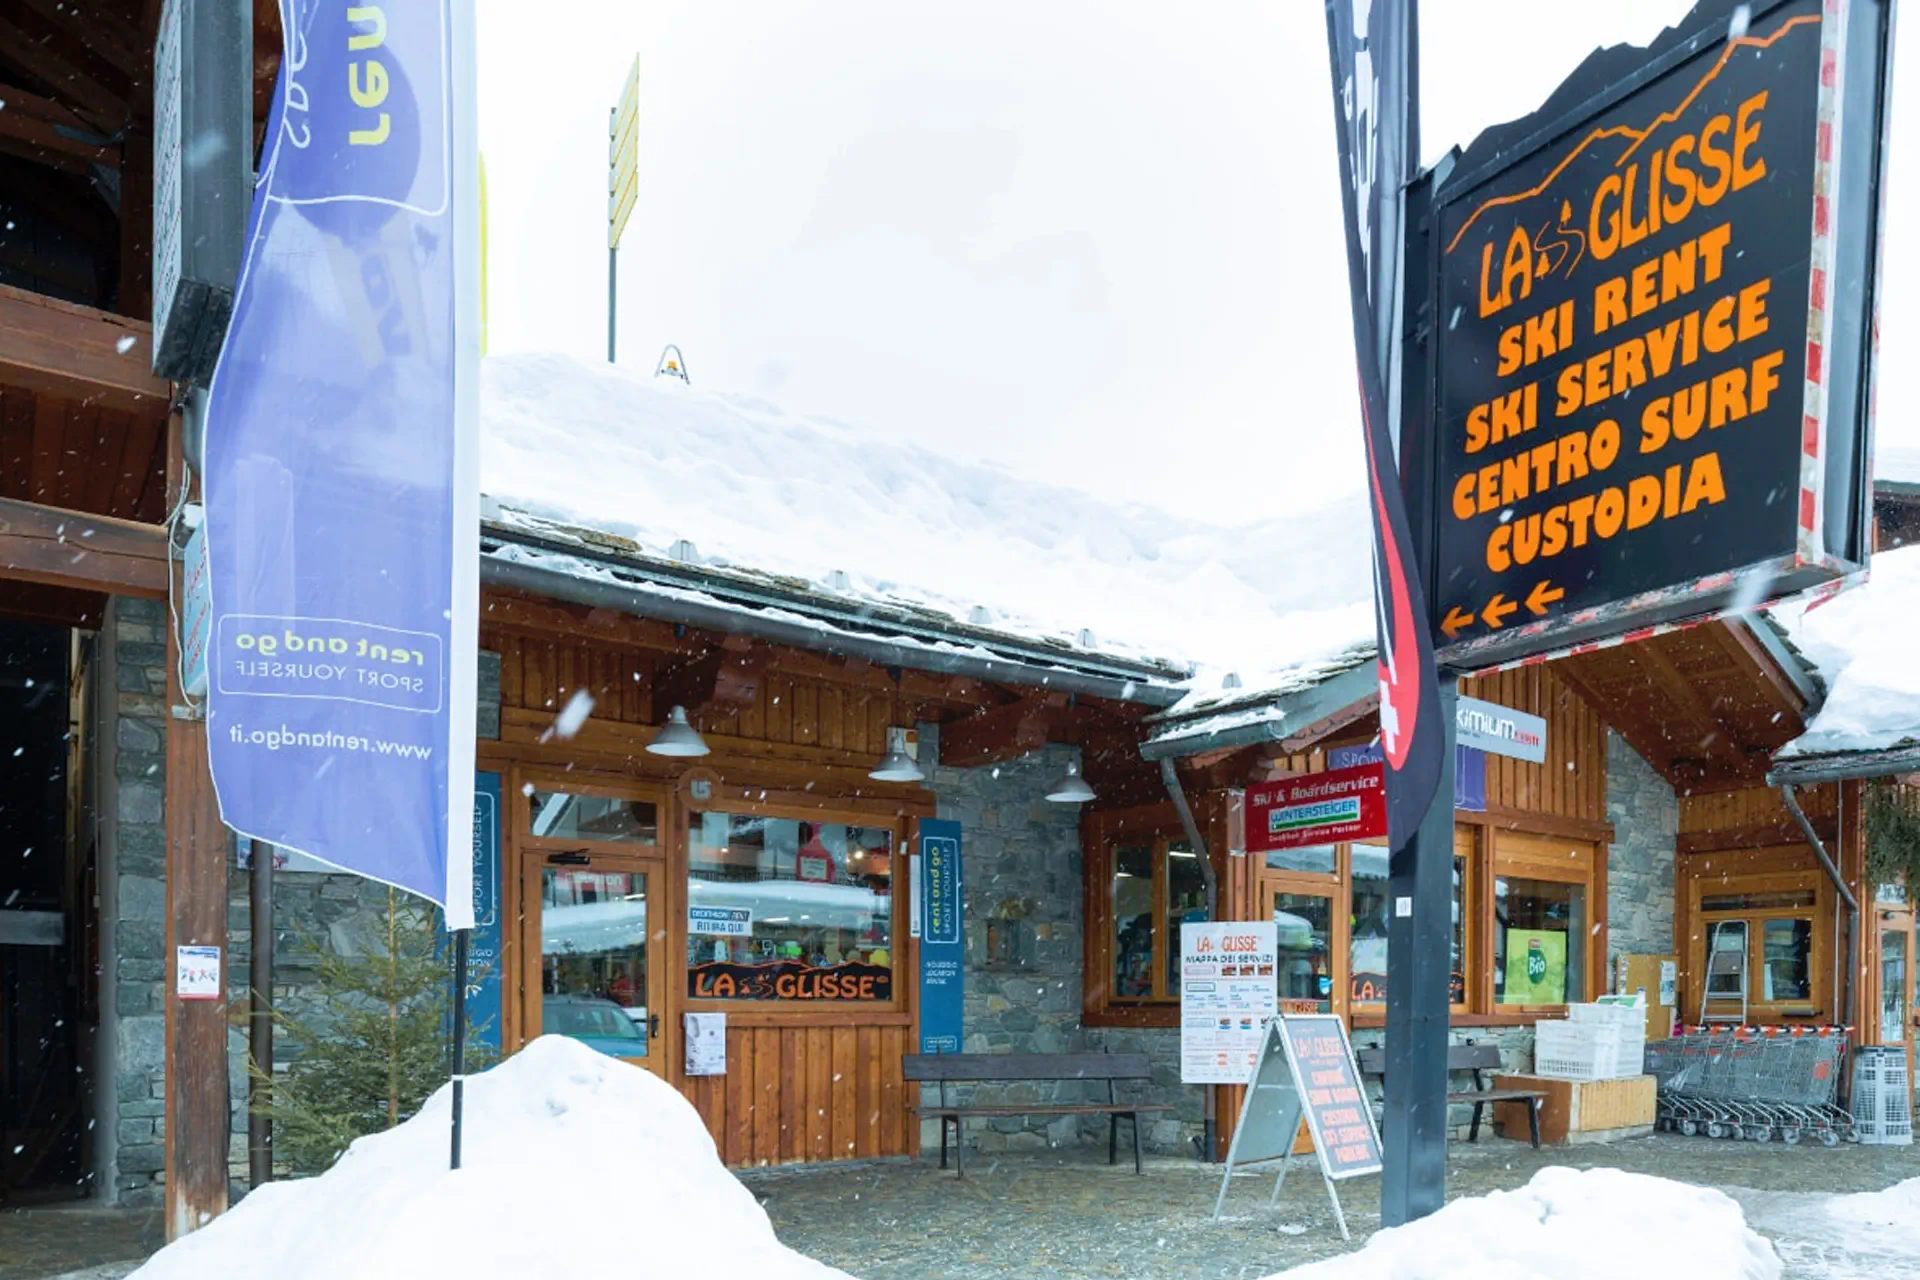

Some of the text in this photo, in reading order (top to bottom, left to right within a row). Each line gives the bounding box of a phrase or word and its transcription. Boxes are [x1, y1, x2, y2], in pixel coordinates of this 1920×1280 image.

[1478, 89, 1769, 319] LA GLISSE
[1497, 223, 1732, 378] SKI RENT
[1465, 278, 1772, 454] SKI SERVICE
[1452, 349, 1785, 521] CENTRO SURF
[1486, 451, 1727, 573] CUSTODIA
[1253, 776, 1379, 806] Ski & Boardservice
[1270, 800, 1357, 823] WINTERSTEIGER
[930, 846, 942, 935] rent and go
[1186, 954, 1273, 964] MAPPA DEI SERVIZI
[1222, 936, 1258, 953] GLISSE
[1529, 956, 1545, 975] Bio
[695, 973, 876, 999] LA GLISSE
[1351, 979, 1375, 1000] LA
